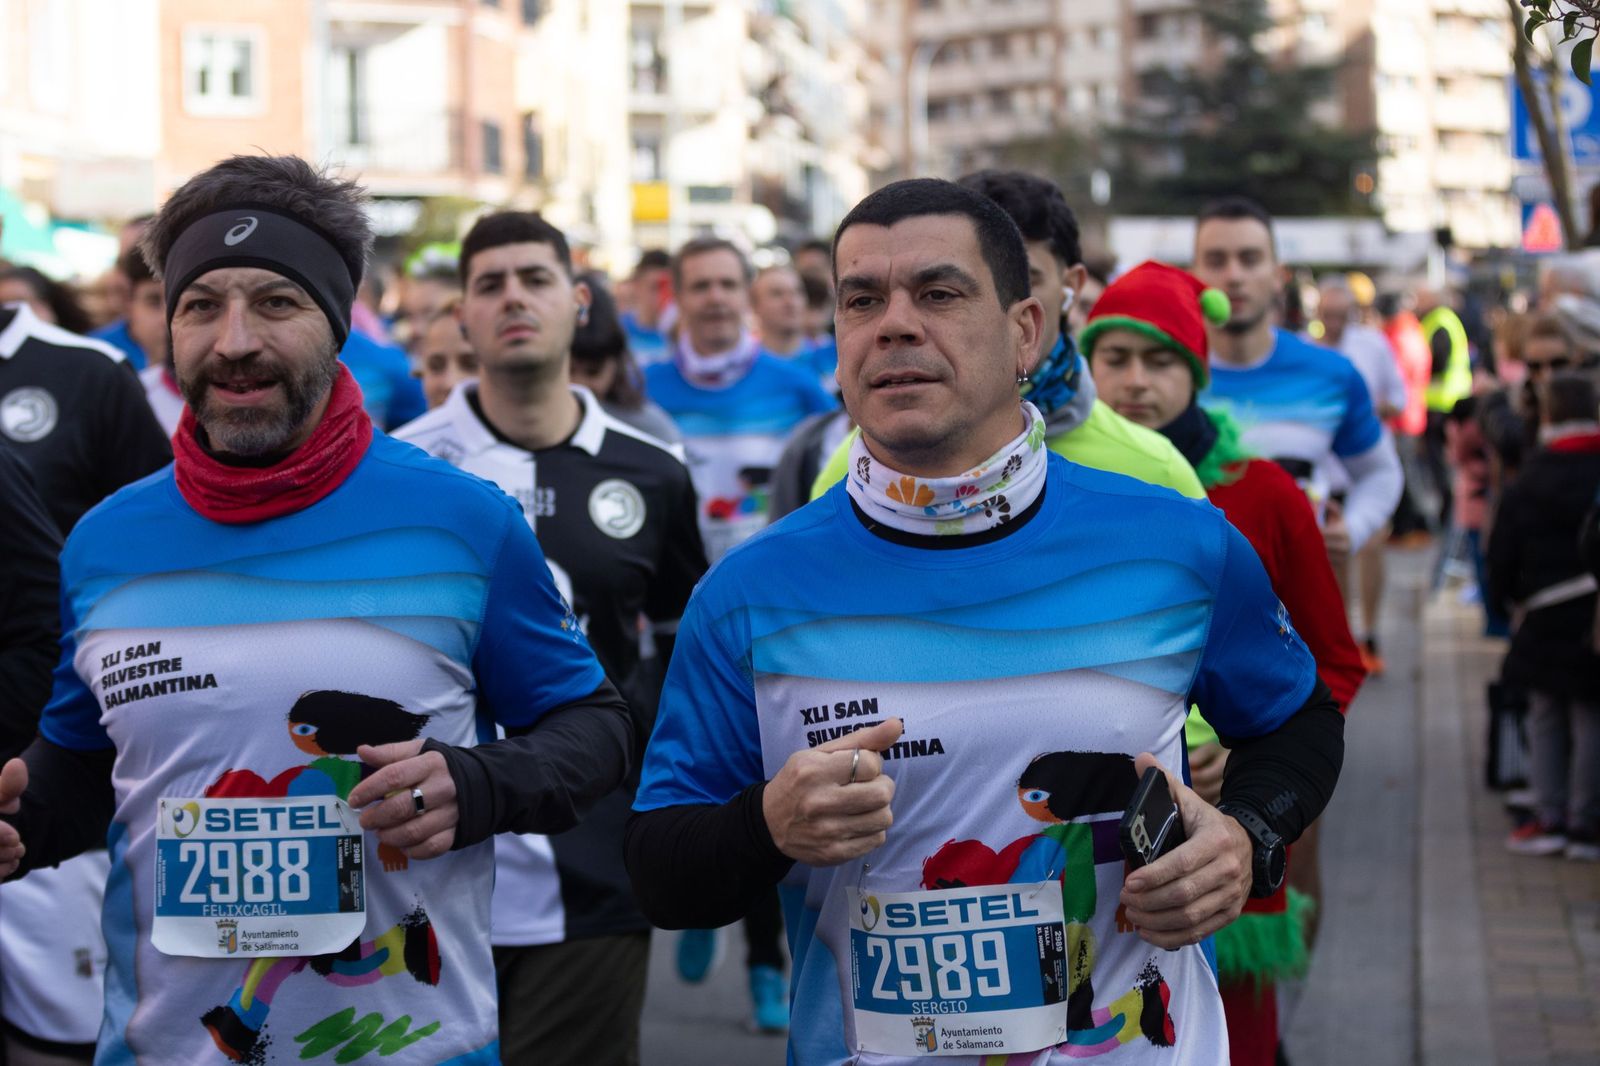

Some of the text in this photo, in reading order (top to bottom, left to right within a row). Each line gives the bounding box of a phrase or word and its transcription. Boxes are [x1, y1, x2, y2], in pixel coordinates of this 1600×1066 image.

[101, 641, 161, 671] XLI SAN
[101, 657, 182, 690] SILVESTRE
[105, 673, 218, 709] SALMANTINA
[800, 698, 879, 726] XLI SAN
[806, 718, 905, 748] SILVE
[205, 806, 341, 833] SETEL
[179, 840, 310, 904] 2988
[203, 904, 287, 917] FELIXCAGIL
[885, 893, 1039, 928] SETEL
[241, 929, 299, 941] Ayuntamiento
[242, 941, 299, 952] de Salamanca
[1054, 930, 1063, 952] 2989
[866, 931, 1012, 1001] 2989
[912, 1000, 968, 1014] SERGIO
[940, 1026, 1003, 1038] Ayuntamiento
[943, 1038, 1004, 1049] de Salamanca
